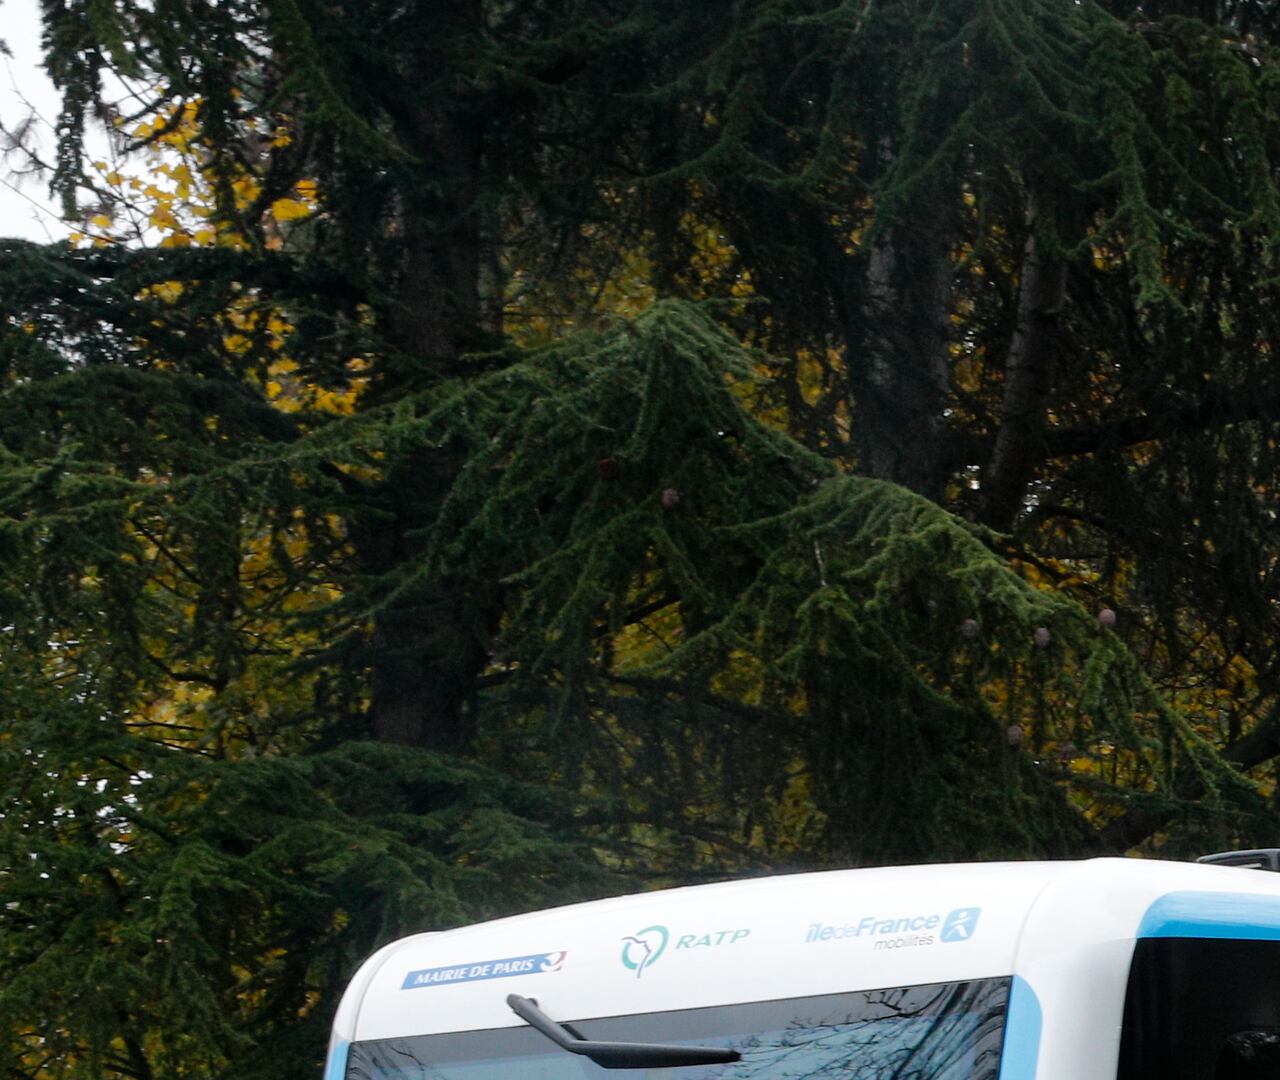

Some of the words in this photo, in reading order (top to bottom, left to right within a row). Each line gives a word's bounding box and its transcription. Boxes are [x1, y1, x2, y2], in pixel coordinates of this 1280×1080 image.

[675, 929, 751, 949] RATP
[414, 967, 468, 985] MAIRIE
[469, 965, 491, 978] DE
[492, 959, 535, 974] PARIS
